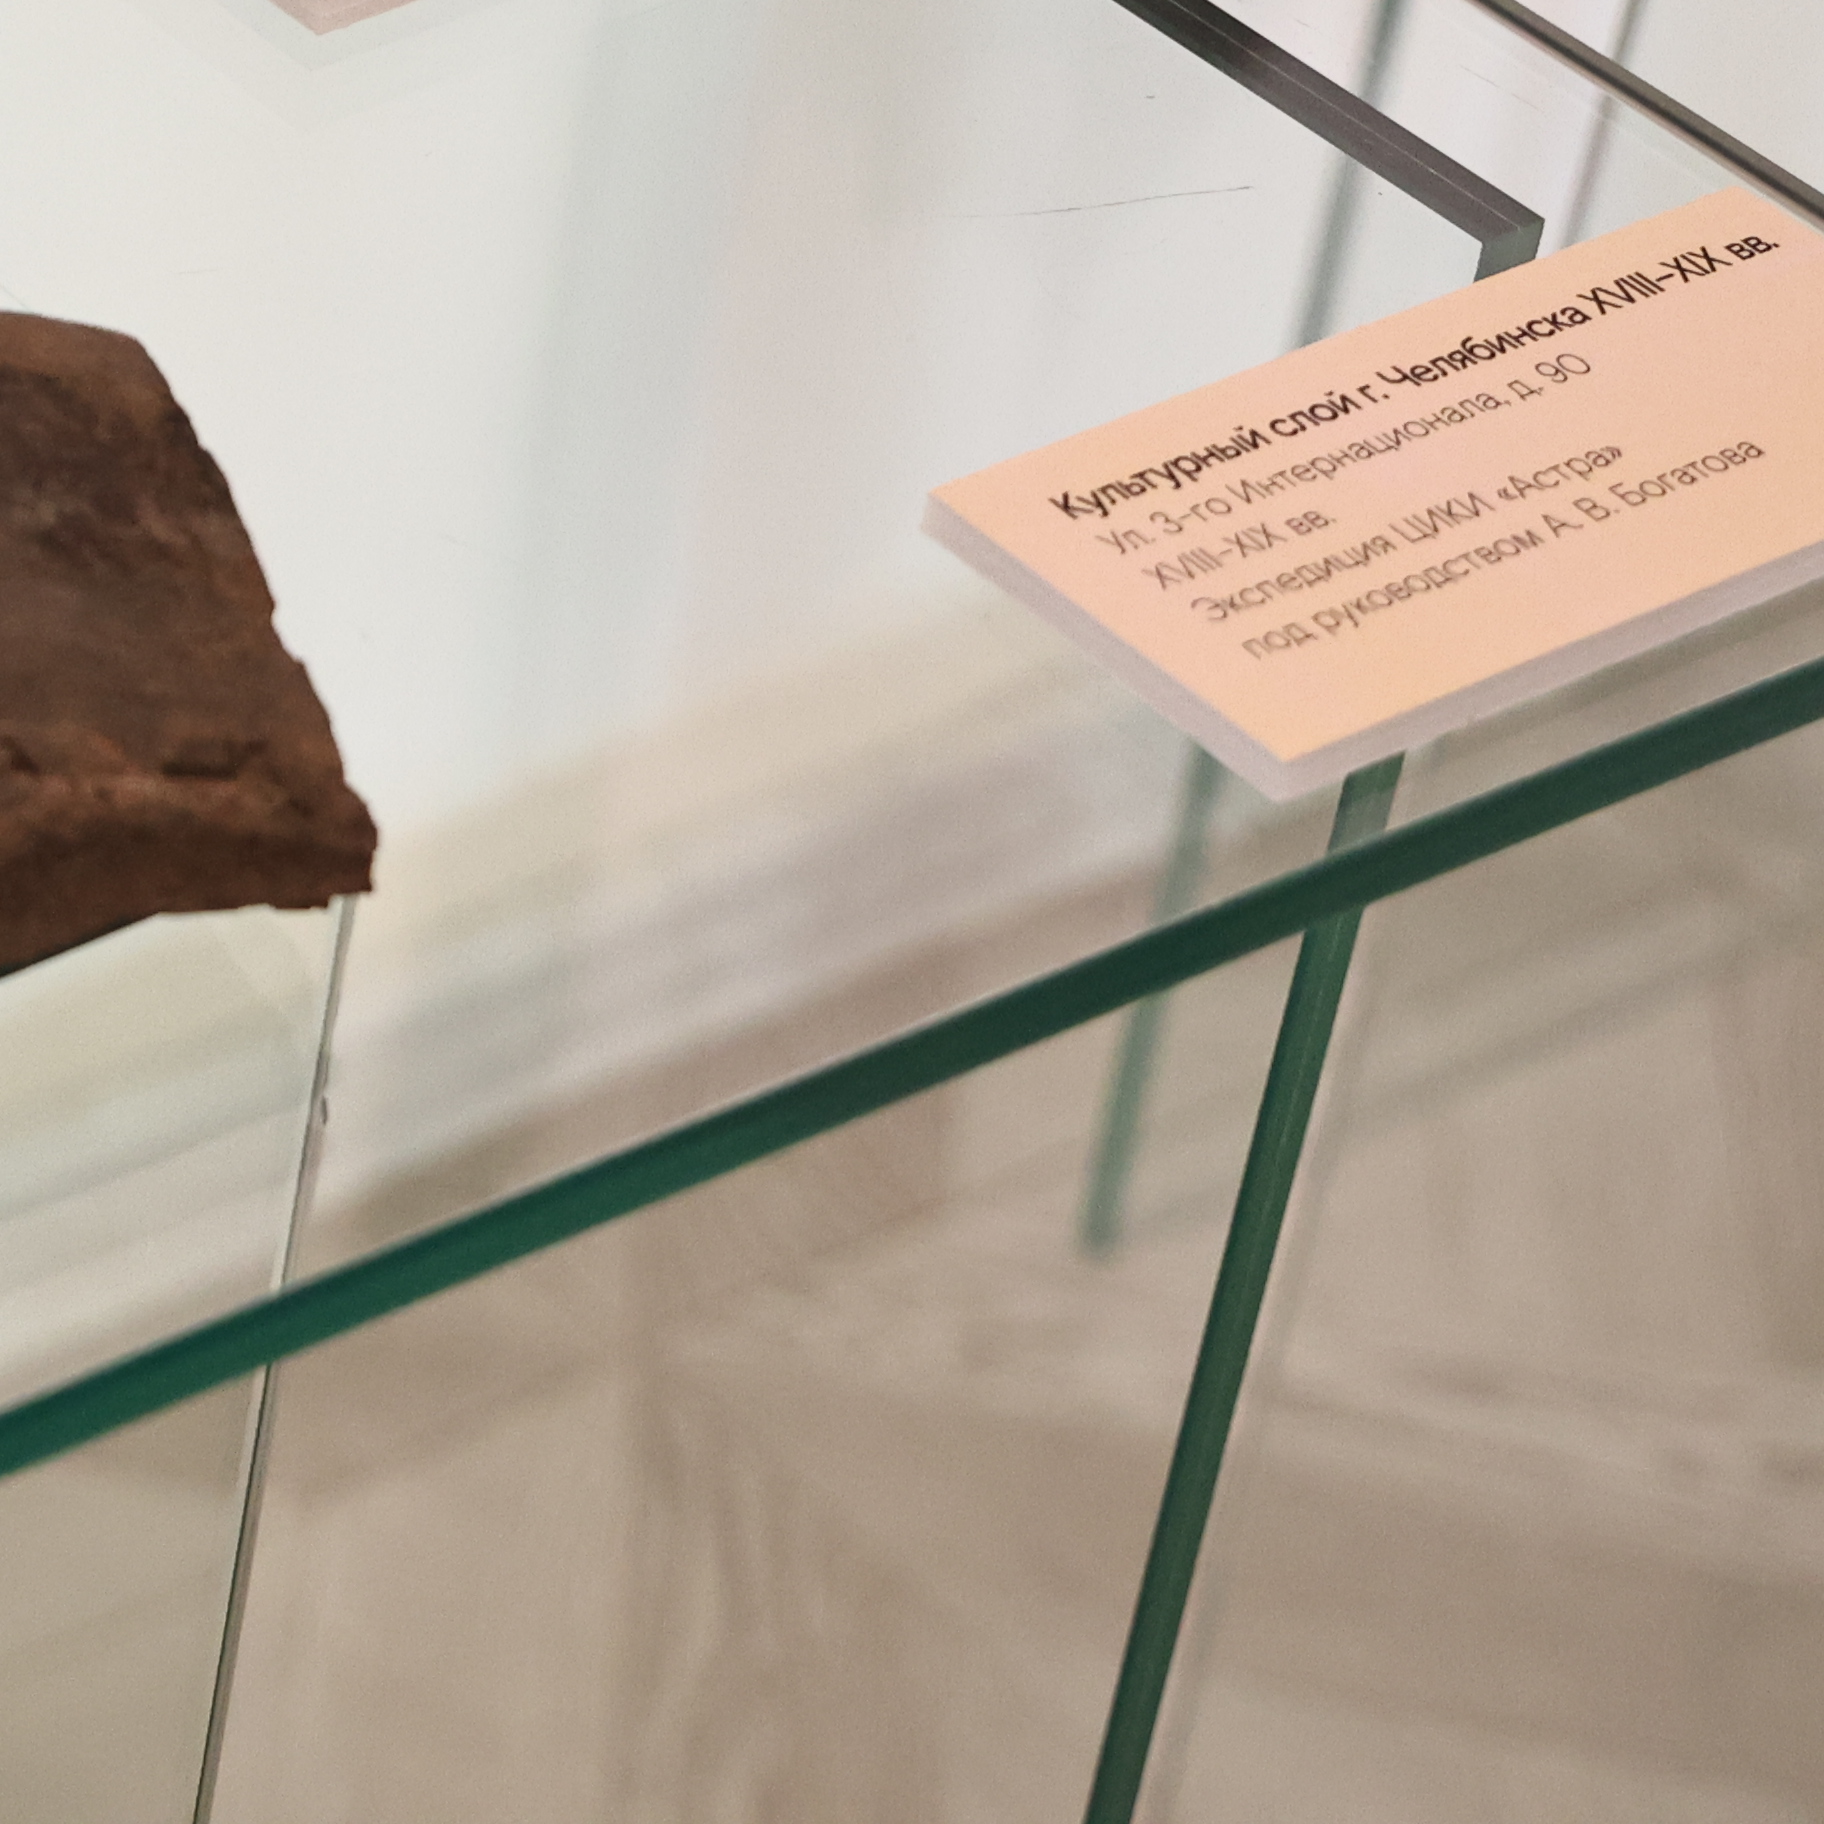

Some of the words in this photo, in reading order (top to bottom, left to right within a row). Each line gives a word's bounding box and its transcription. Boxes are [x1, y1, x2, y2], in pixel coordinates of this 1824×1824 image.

[1047, 424, 1272, 520] Культурный
[1267, 389, 1363, 438] слой
[1355, 382, 1391, 404] г.
[1374, 305, 1593, 387] Челябинска
[1722, 234, 1780, 261] вв.
[1094, 527, 1156, 556] Ул.
[1224, 391, 1512, 505] Интернационала,
[1505, 378, 1545, 402] д.
[1532, 352, 1592, 384] 90
[1189, 533, 1398, 622] Экспедиция
[1388, 490, 1496, 544] ЦИКИ
[1239, 620, 1319, 660] под
[1309, 527, 1546, 636] руководством
[1539, 512, 1585, 539] А.
[1570, 495, 1620, 523] В.
[1606, 440, 1766, 508] Богатова
[1283, 509, 1337, 537] вв.
